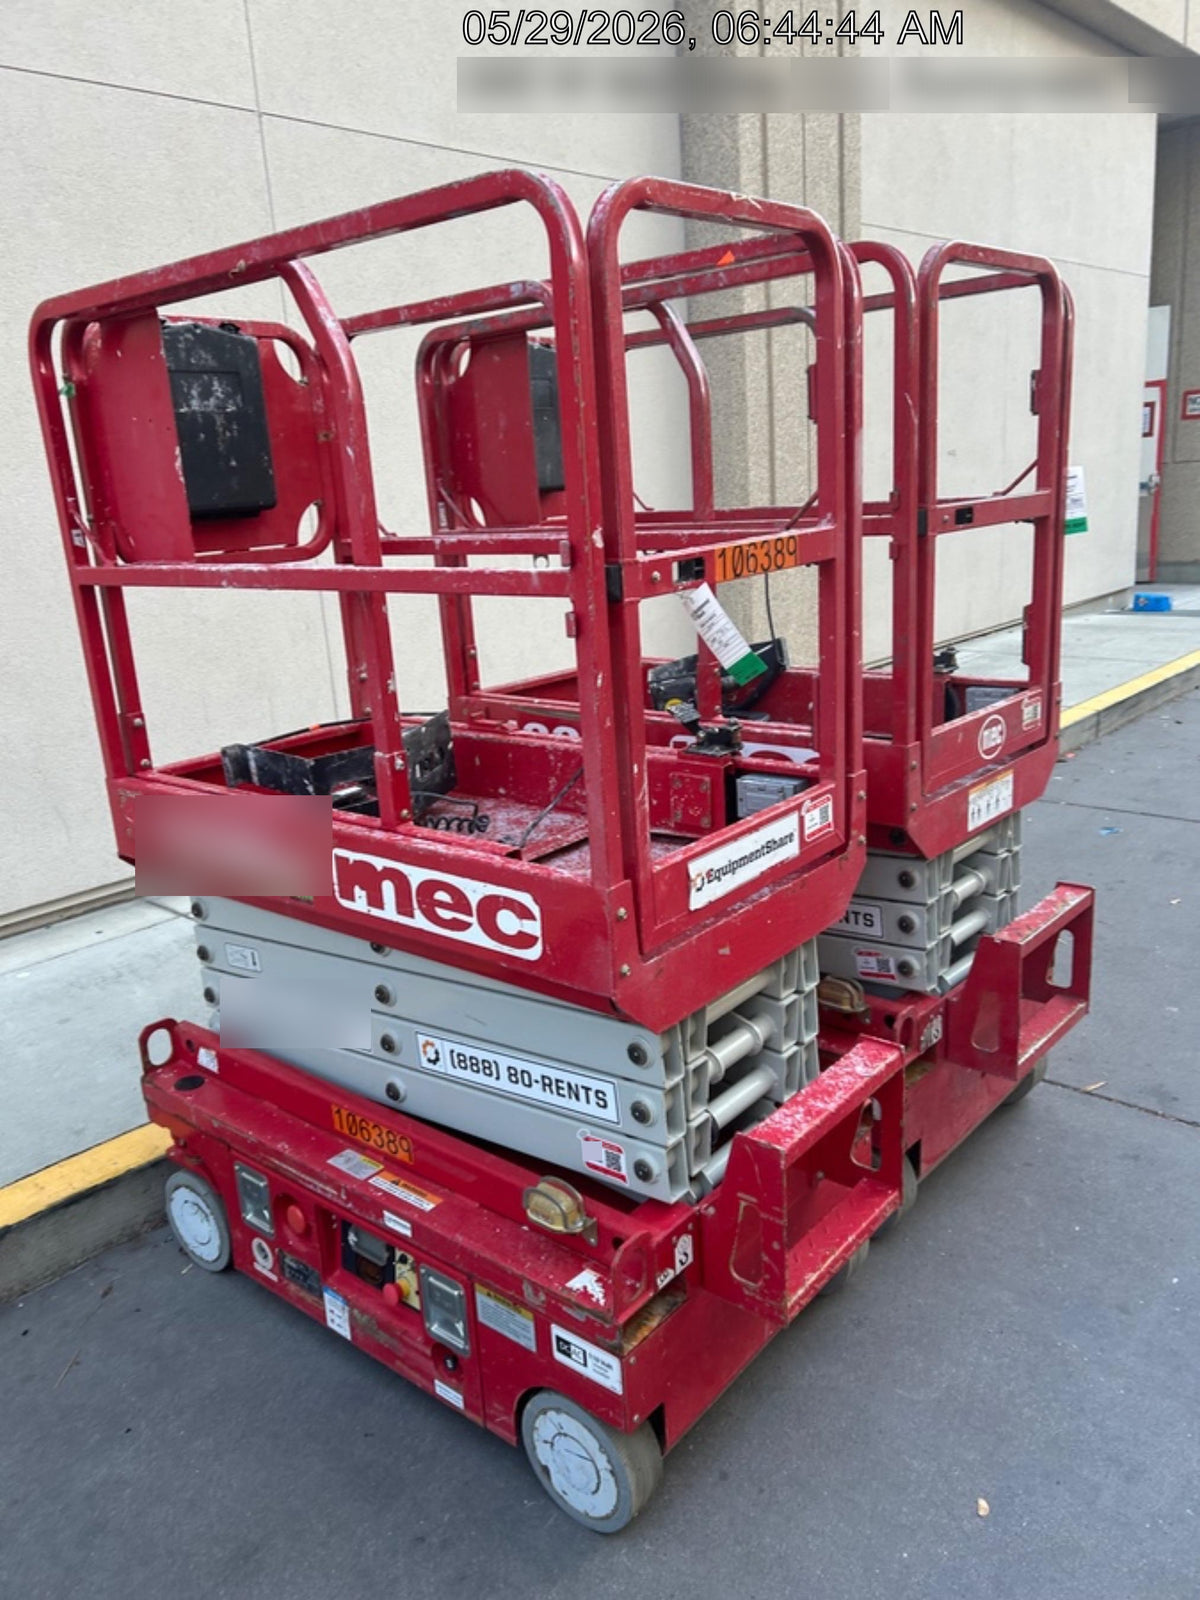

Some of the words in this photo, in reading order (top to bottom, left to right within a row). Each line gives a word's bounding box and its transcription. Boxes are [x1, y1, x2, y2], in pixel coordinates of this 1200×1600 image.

[717, 535, 797, 580] 106389
[705, 831, 795, 884] EquipmentShare
[450, 1049, 500, 1081] (888)
[506, 1065, 609, 1110] 80-RENTS
[334, 1108, 414, 1163] 106389
